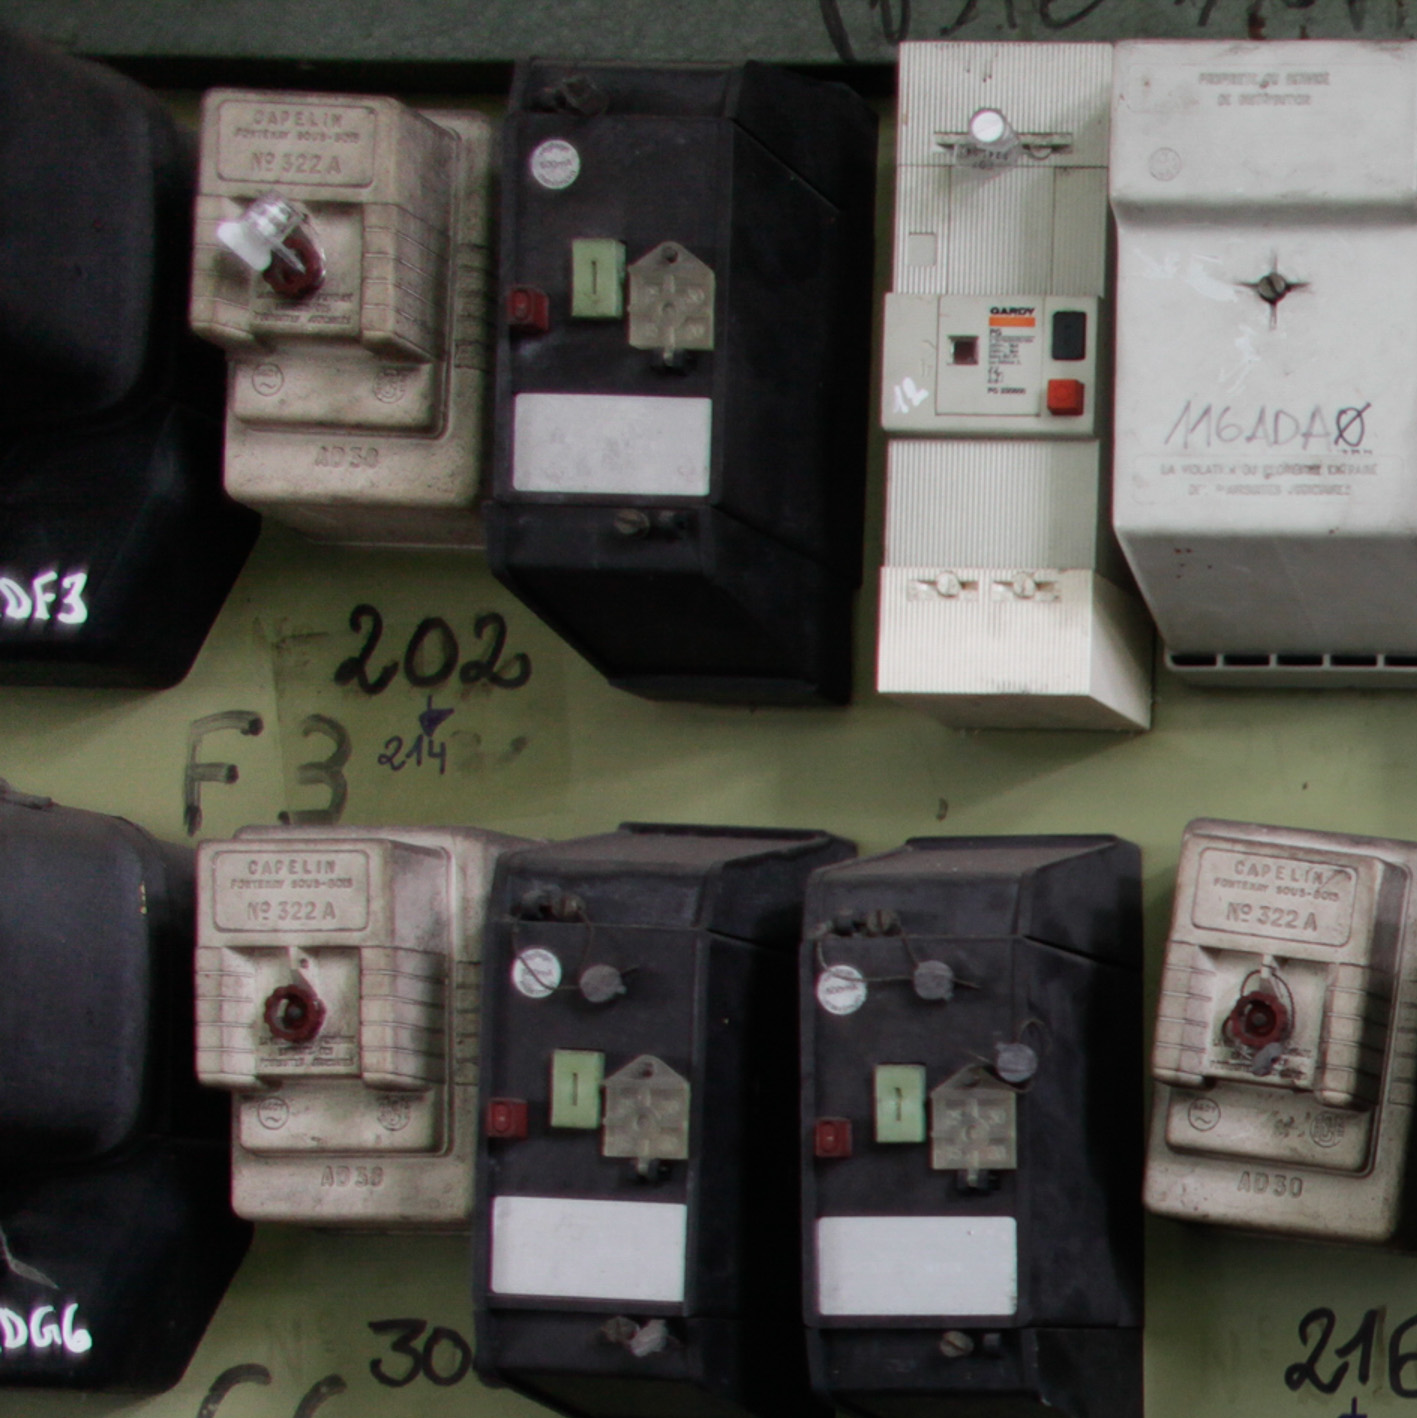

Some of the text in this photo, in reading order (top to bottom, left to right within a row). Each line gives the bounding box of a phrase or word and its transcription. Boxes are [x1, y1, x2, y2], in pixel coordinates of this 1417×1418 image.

[335, 603, 532, 694] 202
[247, 857, 337, 876] CAPELIN
[1233, 860, 1325, 886] CAPELIN
[277, 900, 319, 921] 322
[1257, 906, 1297, 929] 322
